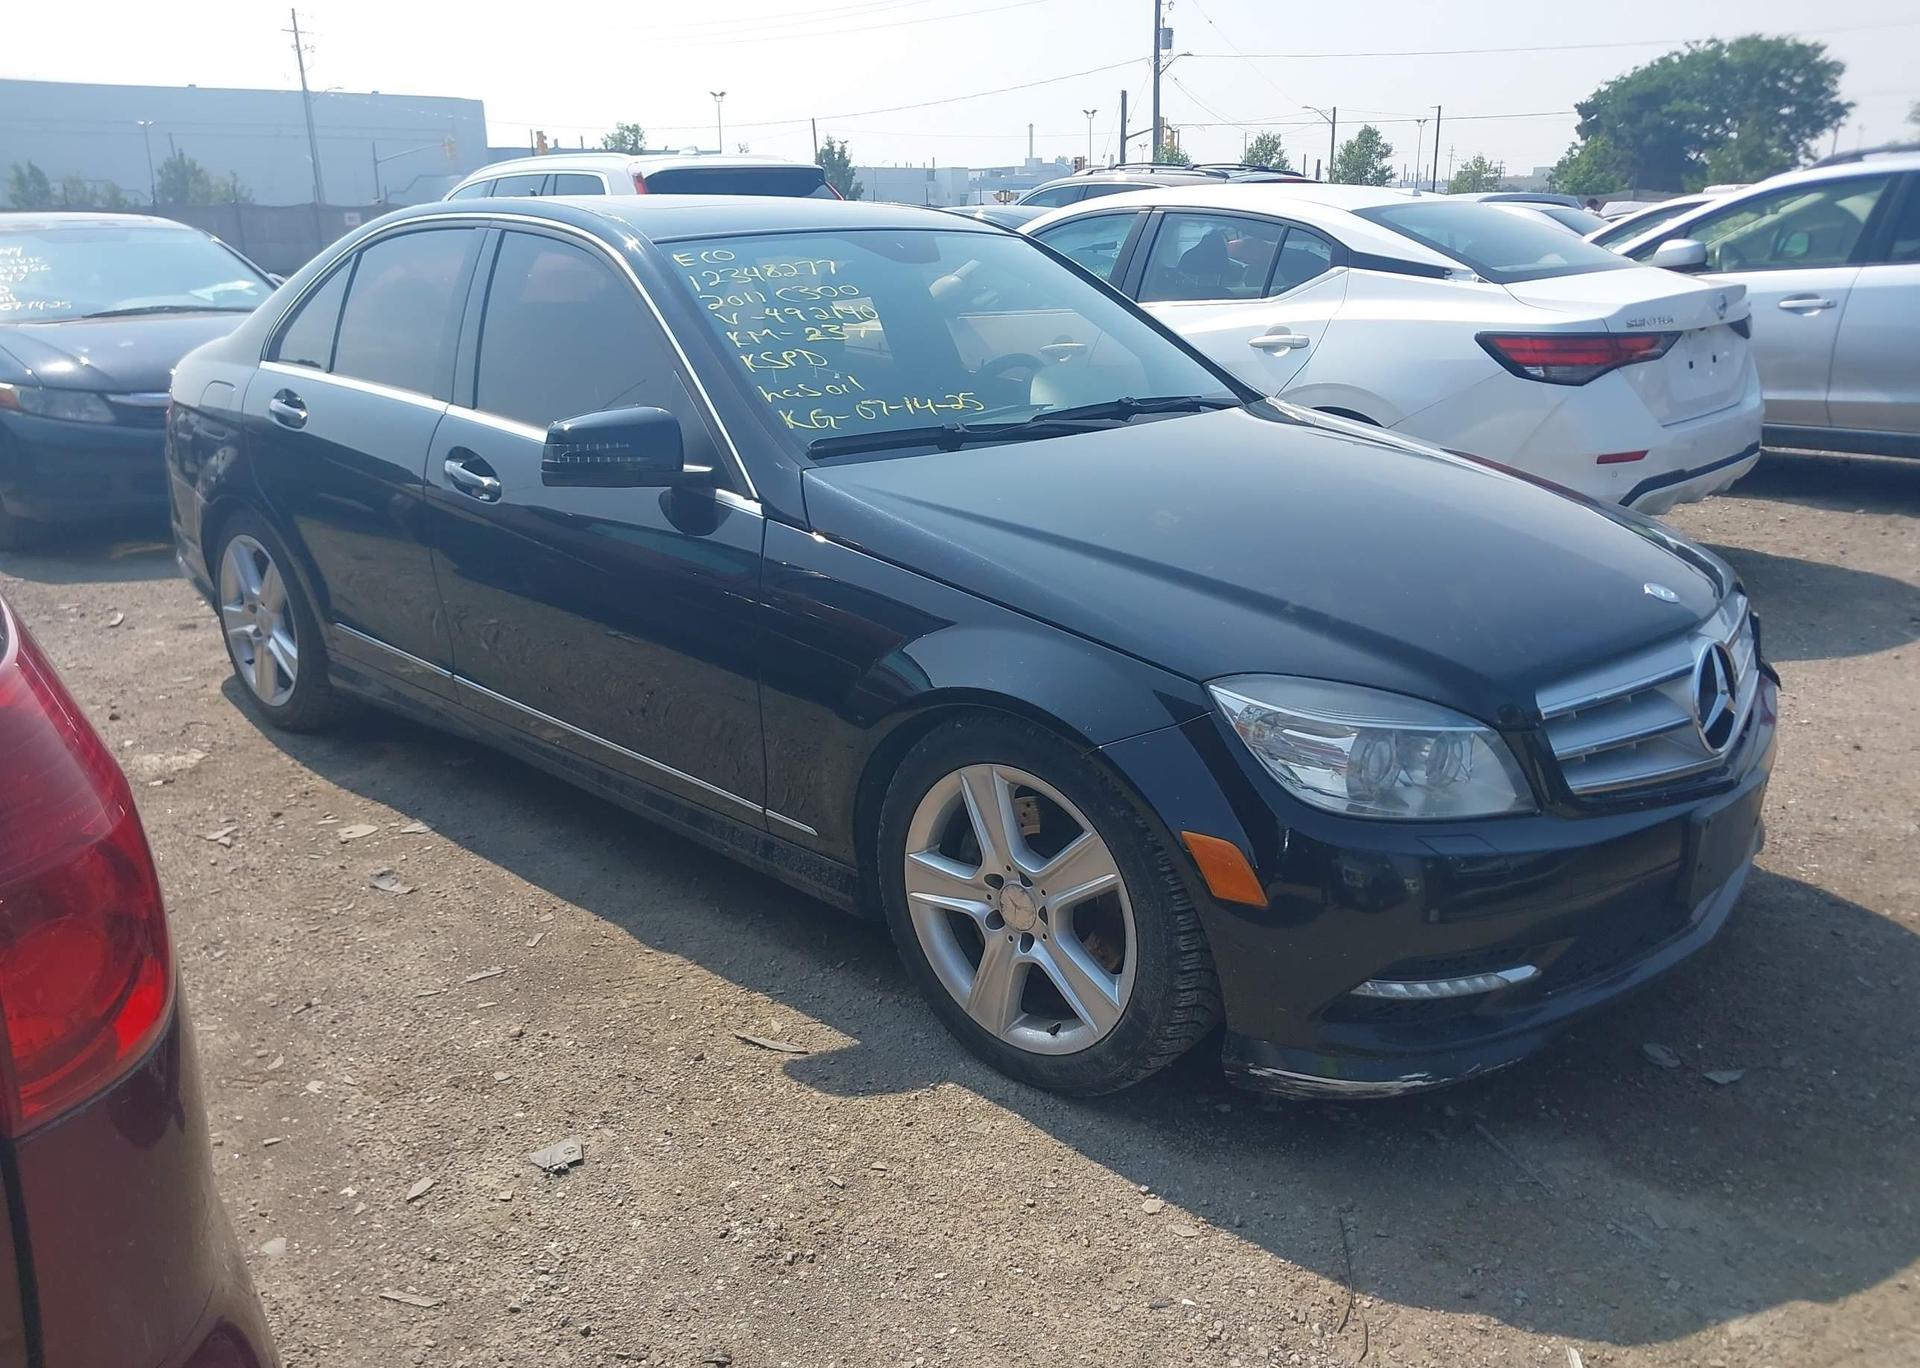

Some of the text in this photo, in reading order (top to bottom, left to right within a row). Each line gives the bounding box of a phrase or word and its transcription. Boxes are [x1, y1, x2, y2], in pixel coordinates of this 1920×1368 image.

[672, 249, 736, 267] ECO
[688, 259, 837, 292] 12348277
[698, 284, 860, 311] 2011 C300
